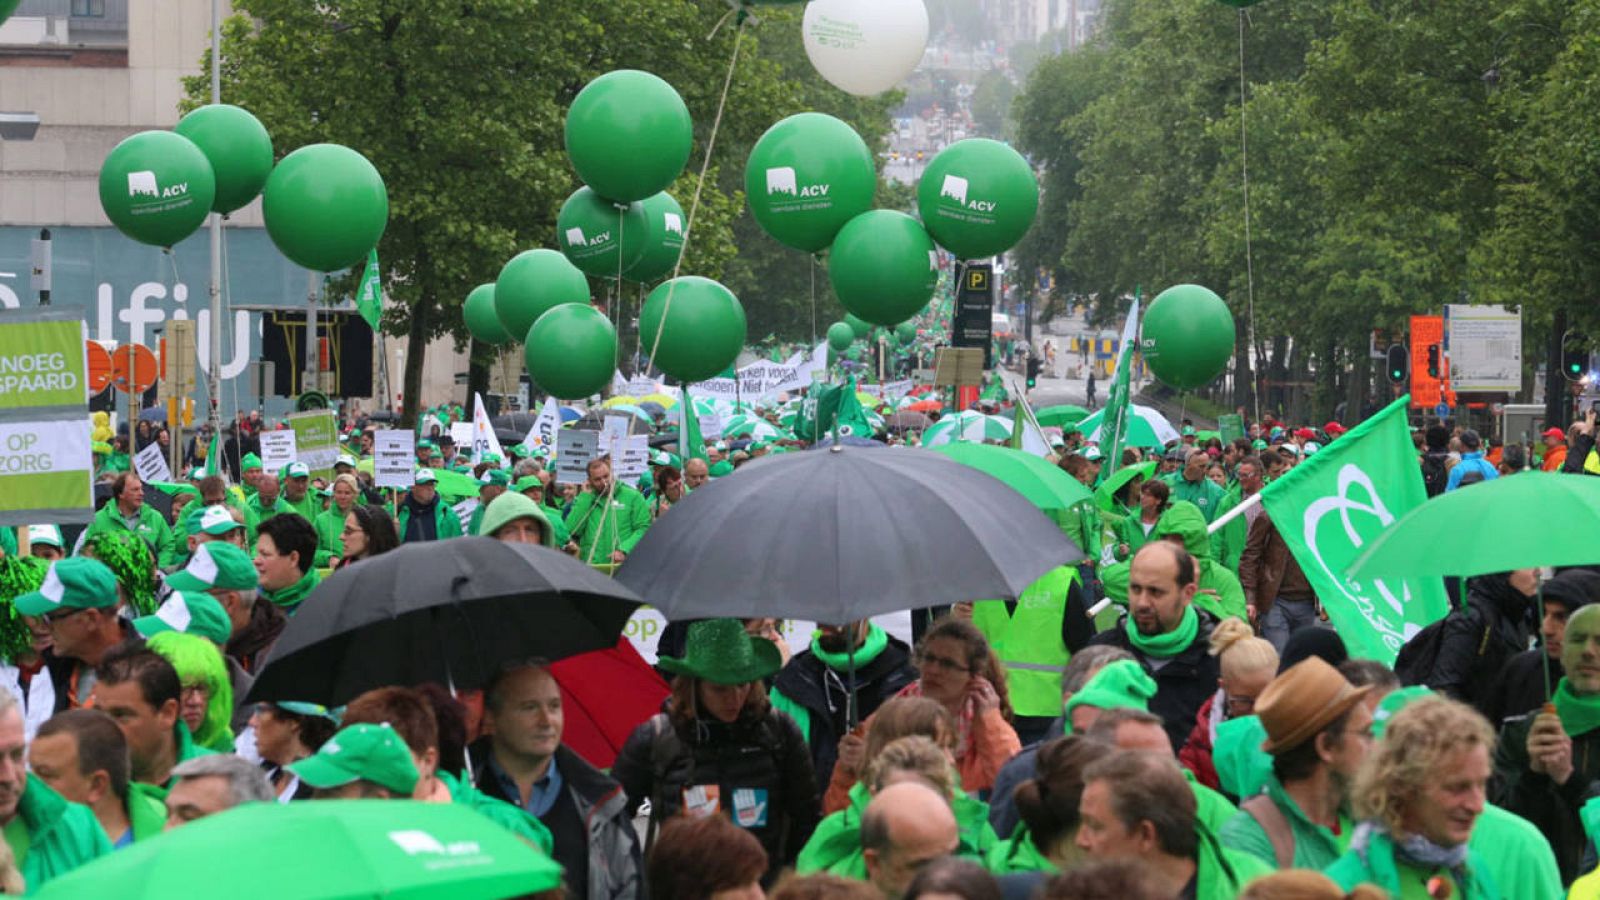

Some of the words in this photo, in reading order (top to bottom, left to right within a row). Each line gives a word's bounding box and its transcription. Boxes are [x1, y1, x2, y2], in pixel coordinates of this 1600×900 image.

[162, 182, 188, 198] ACV
[800, 184, 830, 197] ACV
[968, 199, 997, 212] ACV
[589, 231, 611, 246] ACV
[971, 273, 983, 287] P
[0, 353, 65, 375] NOEG
[7, 433, 38, 451] OP
